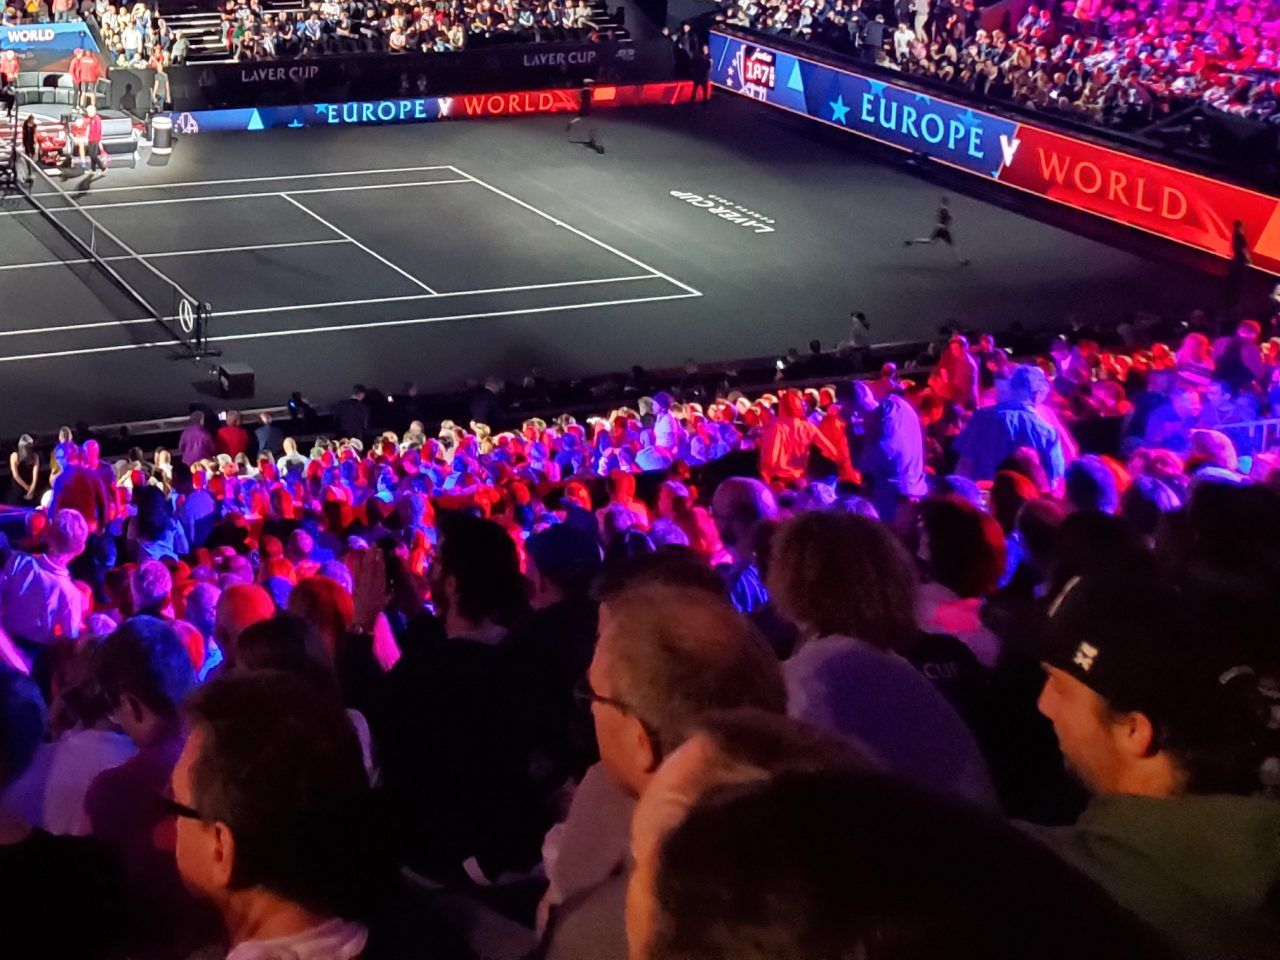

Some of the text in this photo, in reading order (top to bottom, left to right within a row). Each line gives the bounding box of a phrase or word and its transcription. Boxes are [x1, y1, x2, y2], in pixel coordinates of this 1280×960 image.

[7, 27, 55, 43] WORLD
[523, 51, 596, 67] LAVER CUP
[242, 66, 319, 83] LAVER CUP
[328, 99, 427, 124] EUROPE
[464, 93, 554, 116] WORLD
[861, 91, 984, 159] EUROPE
[1038, 147, 1188, 221] WORLD
